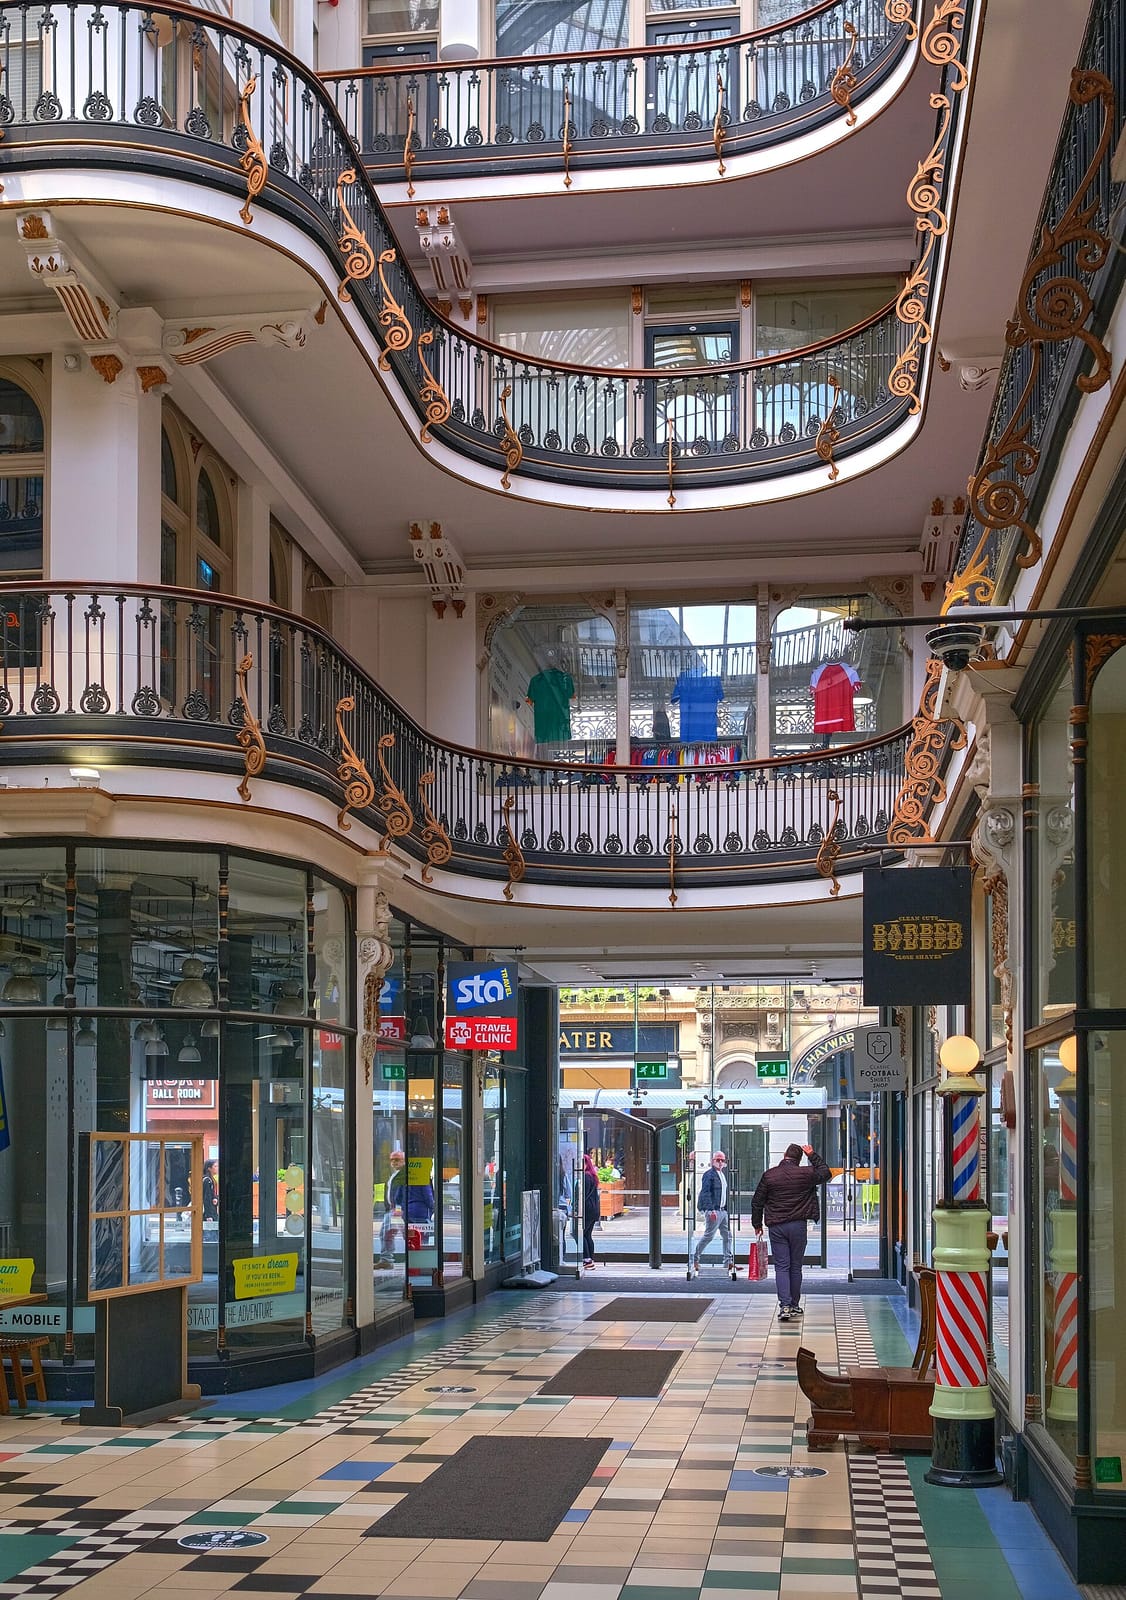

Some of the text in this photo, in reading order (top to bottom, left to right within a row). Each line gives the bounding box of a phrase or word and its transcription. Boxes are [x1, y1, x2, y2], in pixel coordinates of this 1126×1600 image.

[500, 967, 513, 998] TRAVEL
[456, 974, 504, 1004] sta
[451, 1026, 471, 1038] sta
[474, 1023, 512, 1032] TRAVEL
[474, 1033, 512, 1044] CLINIC
[860, 1069, 901, 1077] FOOTBALL
[152, 1088, 201, 1099] BALL ROOM
[268, 1260, 289, 1269] dream
[187, 1301, 273, 1326] START THE ADVENTURE
[12, 1314, 61, 1326] MOBILE
